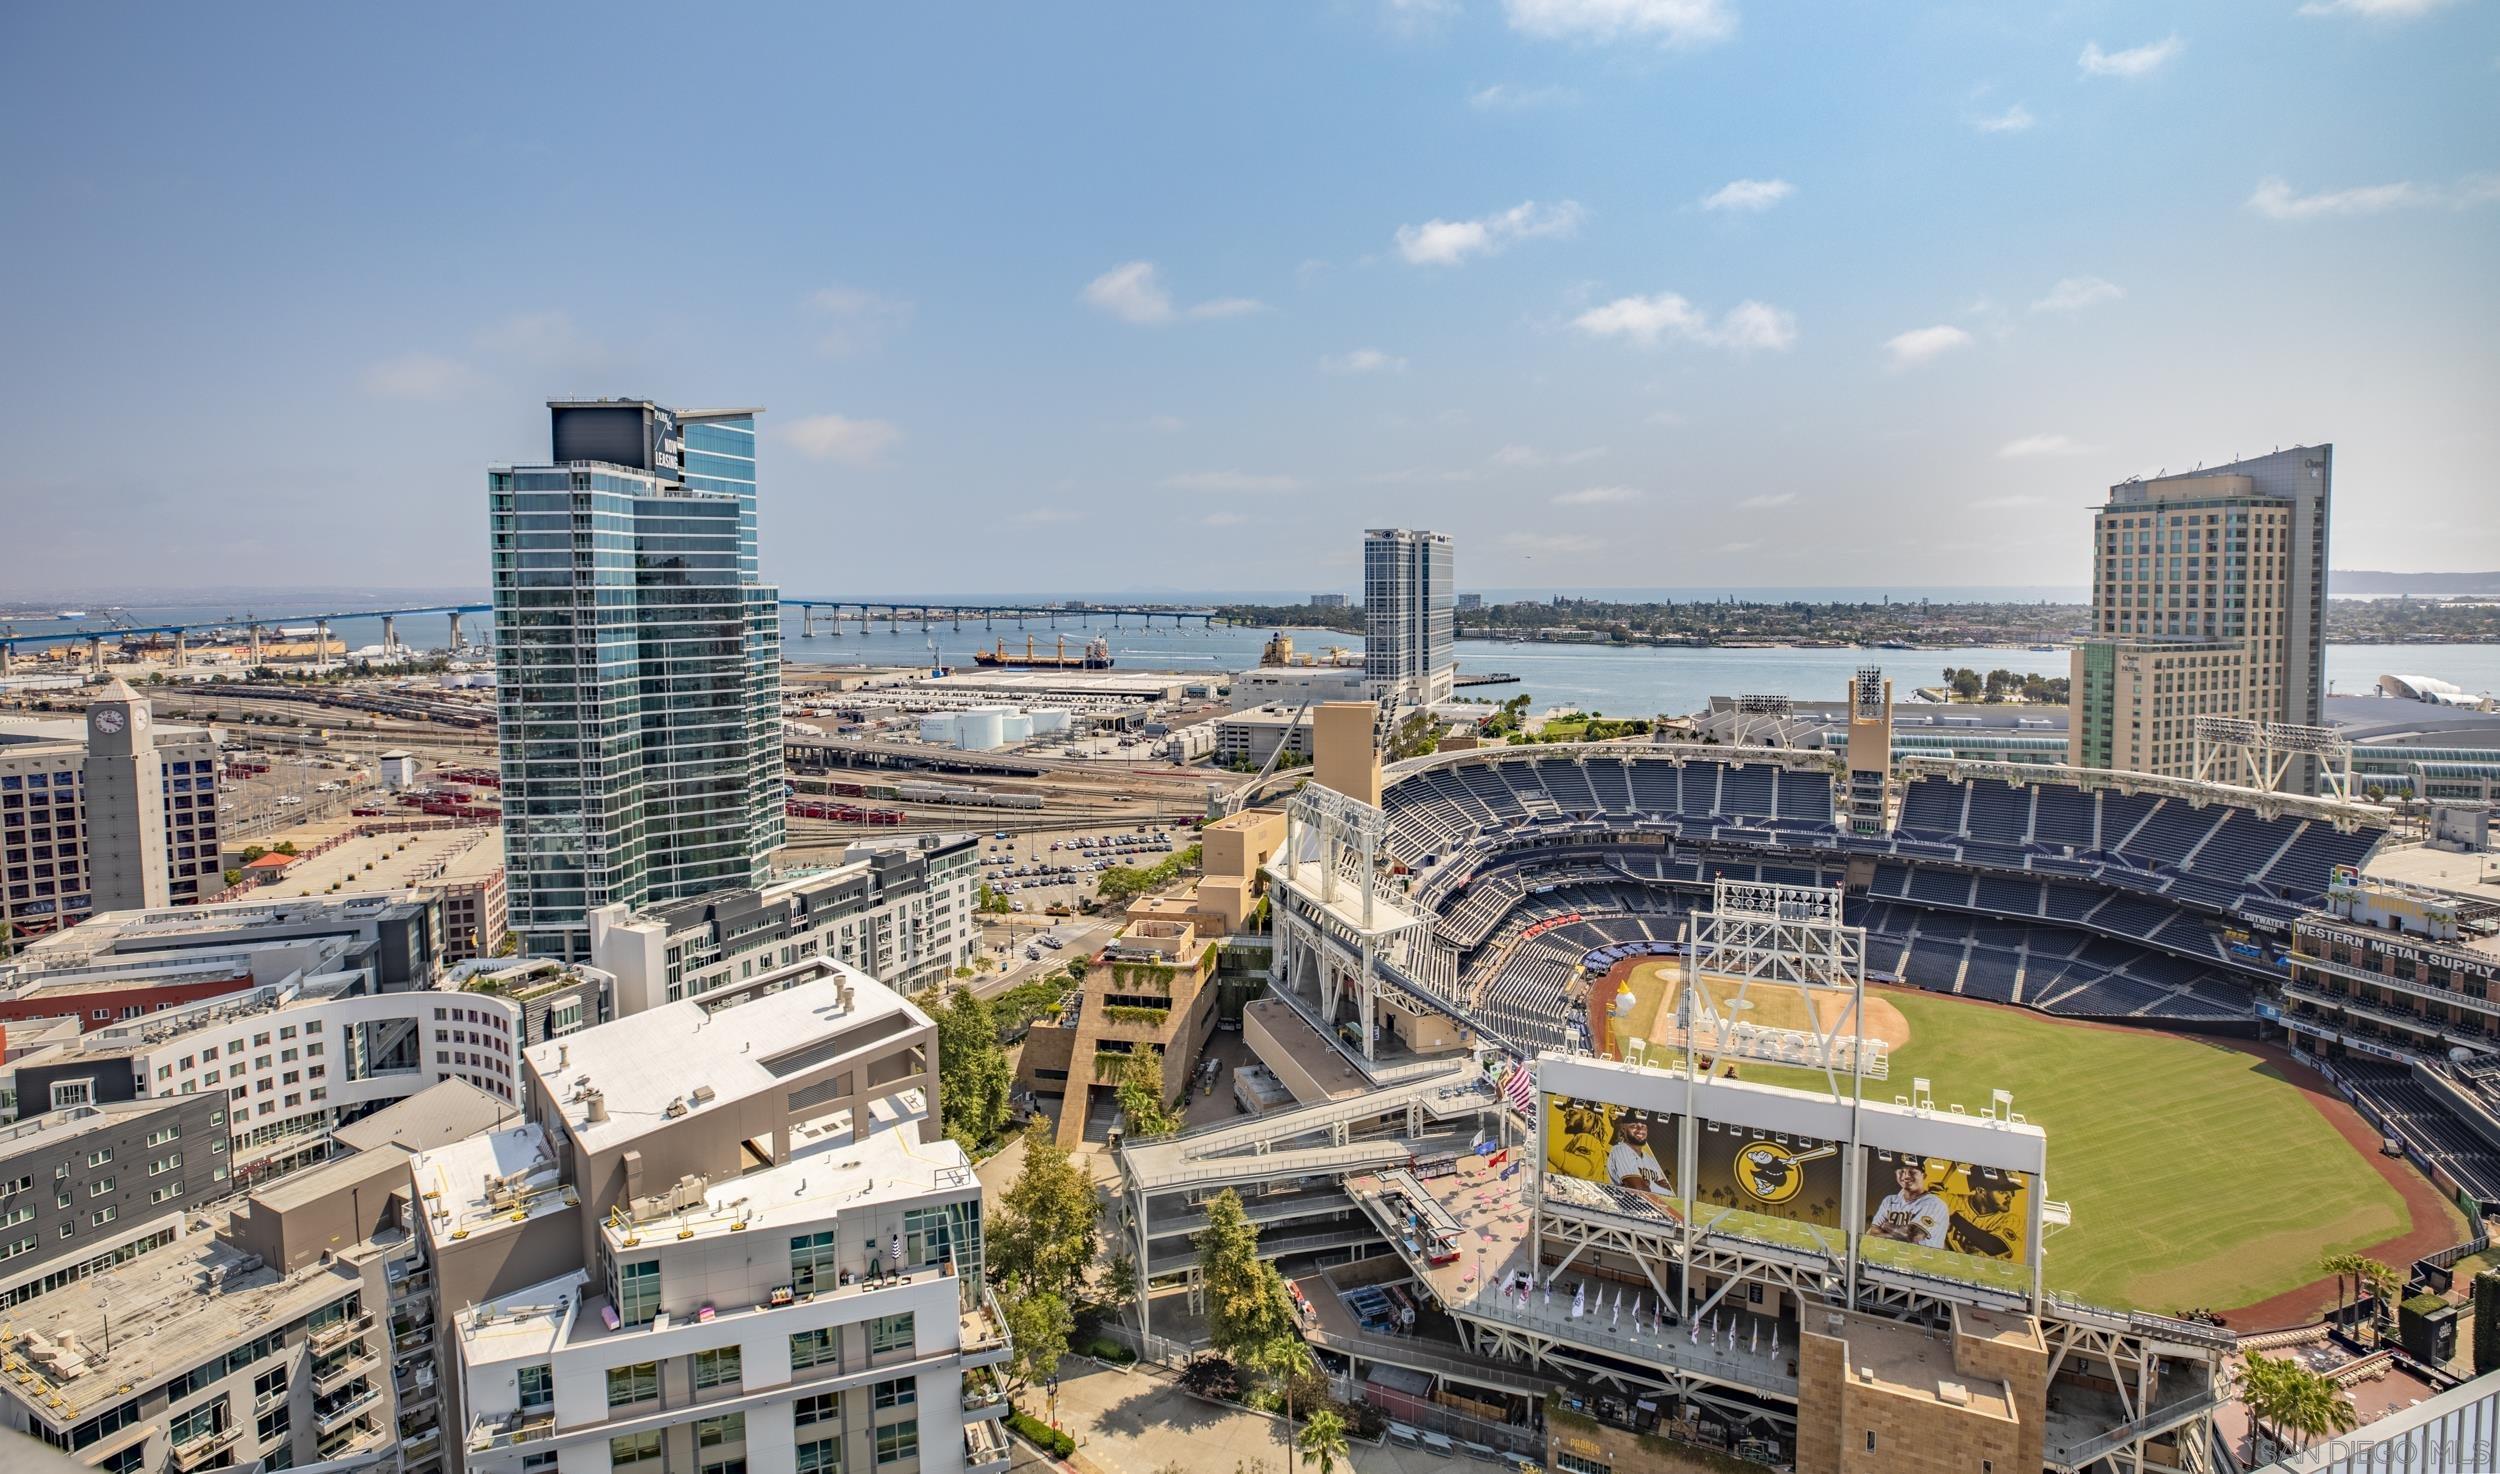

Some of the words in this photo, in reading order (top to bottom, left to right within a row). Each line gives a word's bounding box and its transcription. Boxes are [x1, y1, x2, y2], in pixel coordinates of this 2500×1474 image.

[664, 438, 677, 454] NOW
[656, 451, 678, 470] LEASING
[2244, 912, 2286, 929] CUTWATER
[2296, 922, 2364, 948] WESTERN
[2371, 940, 2424, 962] METAL
[2428, 953, 2496, 979] SUPPLY
